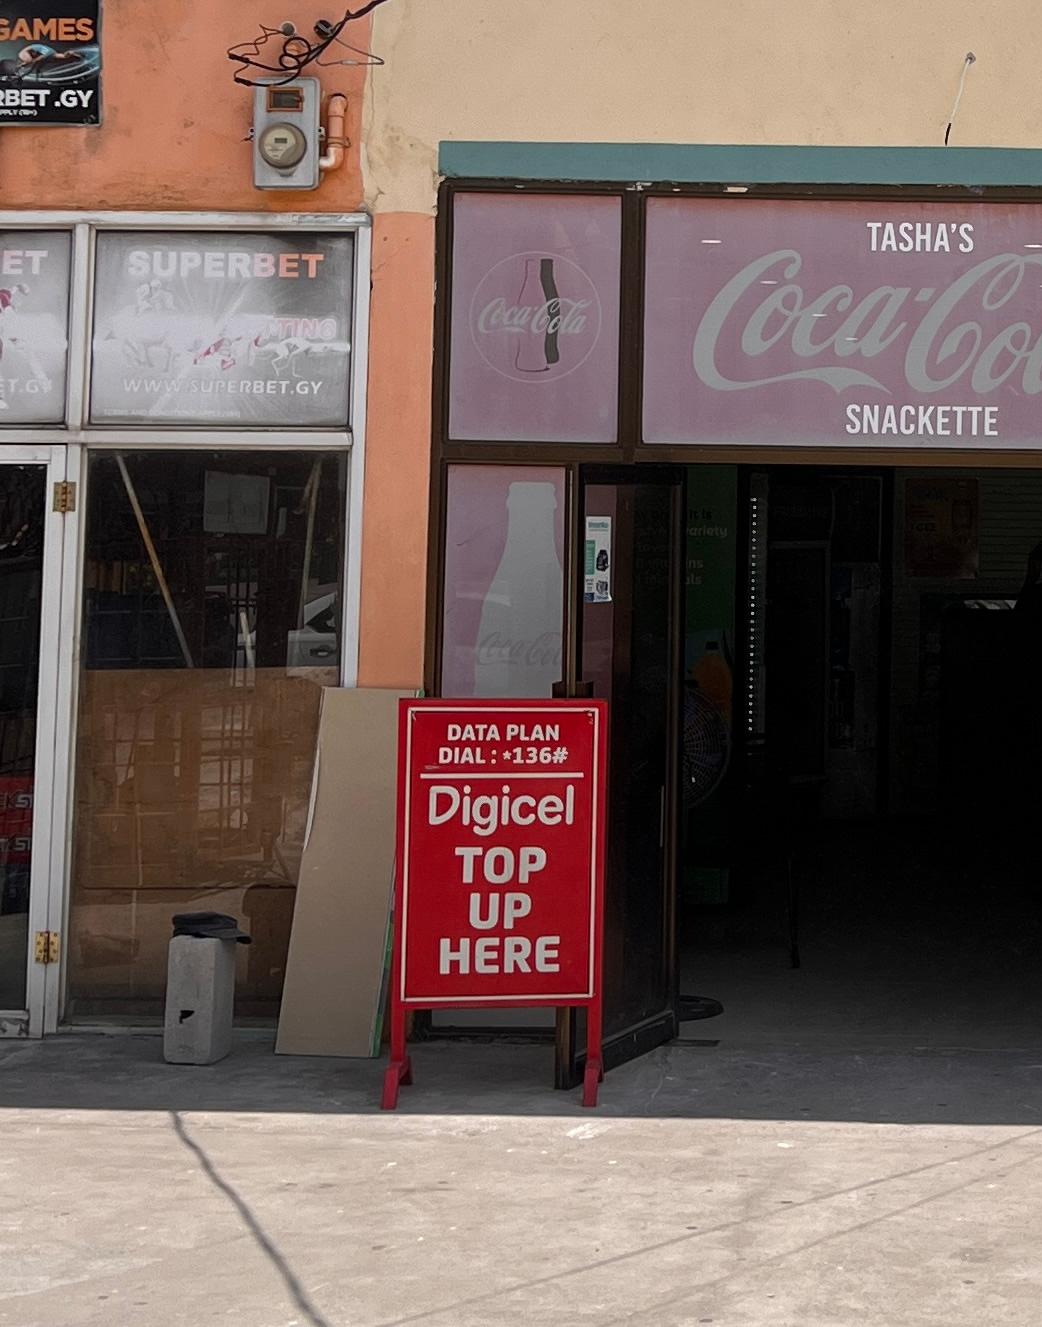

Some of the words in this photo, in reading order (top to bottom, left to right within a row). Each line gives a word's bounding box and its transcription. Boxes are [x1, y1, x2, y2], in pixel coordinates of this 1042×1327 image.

[866, 222, 975, 253] TASHA'S
[128, 250, 325, 279] SUPERBET
[478, 297, 593, 334] Coca-Cola
[845, 404, 999, 436] SNACKETTE
[447, 724, 501, 741] DATA
[506, 724, 560, 741] PLAN
[439, 747, 486, 764] DIAL
[428, 784, 574, 836] Digicel
[455, 846, 547, 884] TOP
[469, 893, 532, 930] UP
[439, 935, 560, 975] HERE
